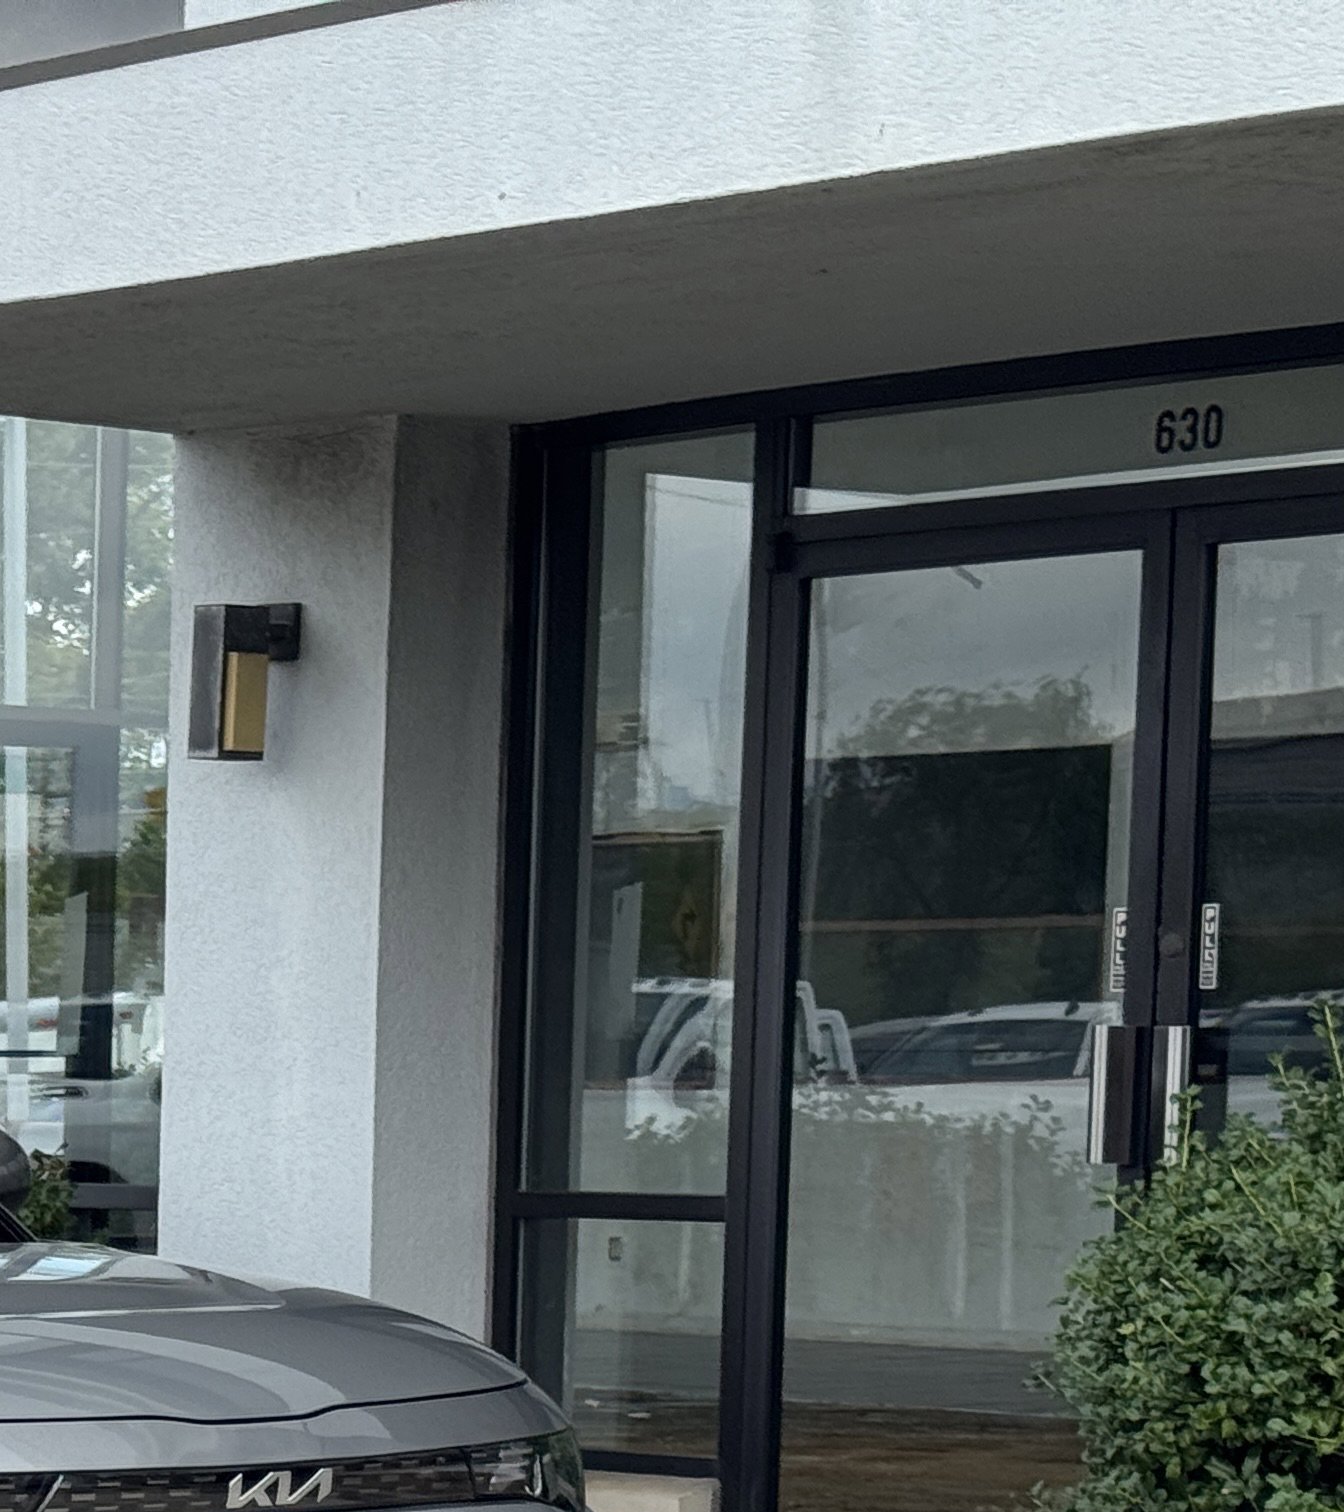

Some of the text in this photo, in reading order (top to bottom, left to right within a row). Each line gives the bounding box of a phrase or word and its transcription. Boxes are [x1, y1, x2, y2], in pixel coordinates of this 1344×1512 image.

[1154, 403, 1224, 455] 630
[1115, 912, 1127, 965] PULL
[1204, 908, 1216, 961] PULL
[224, 1467, 334, 1510] KIA
